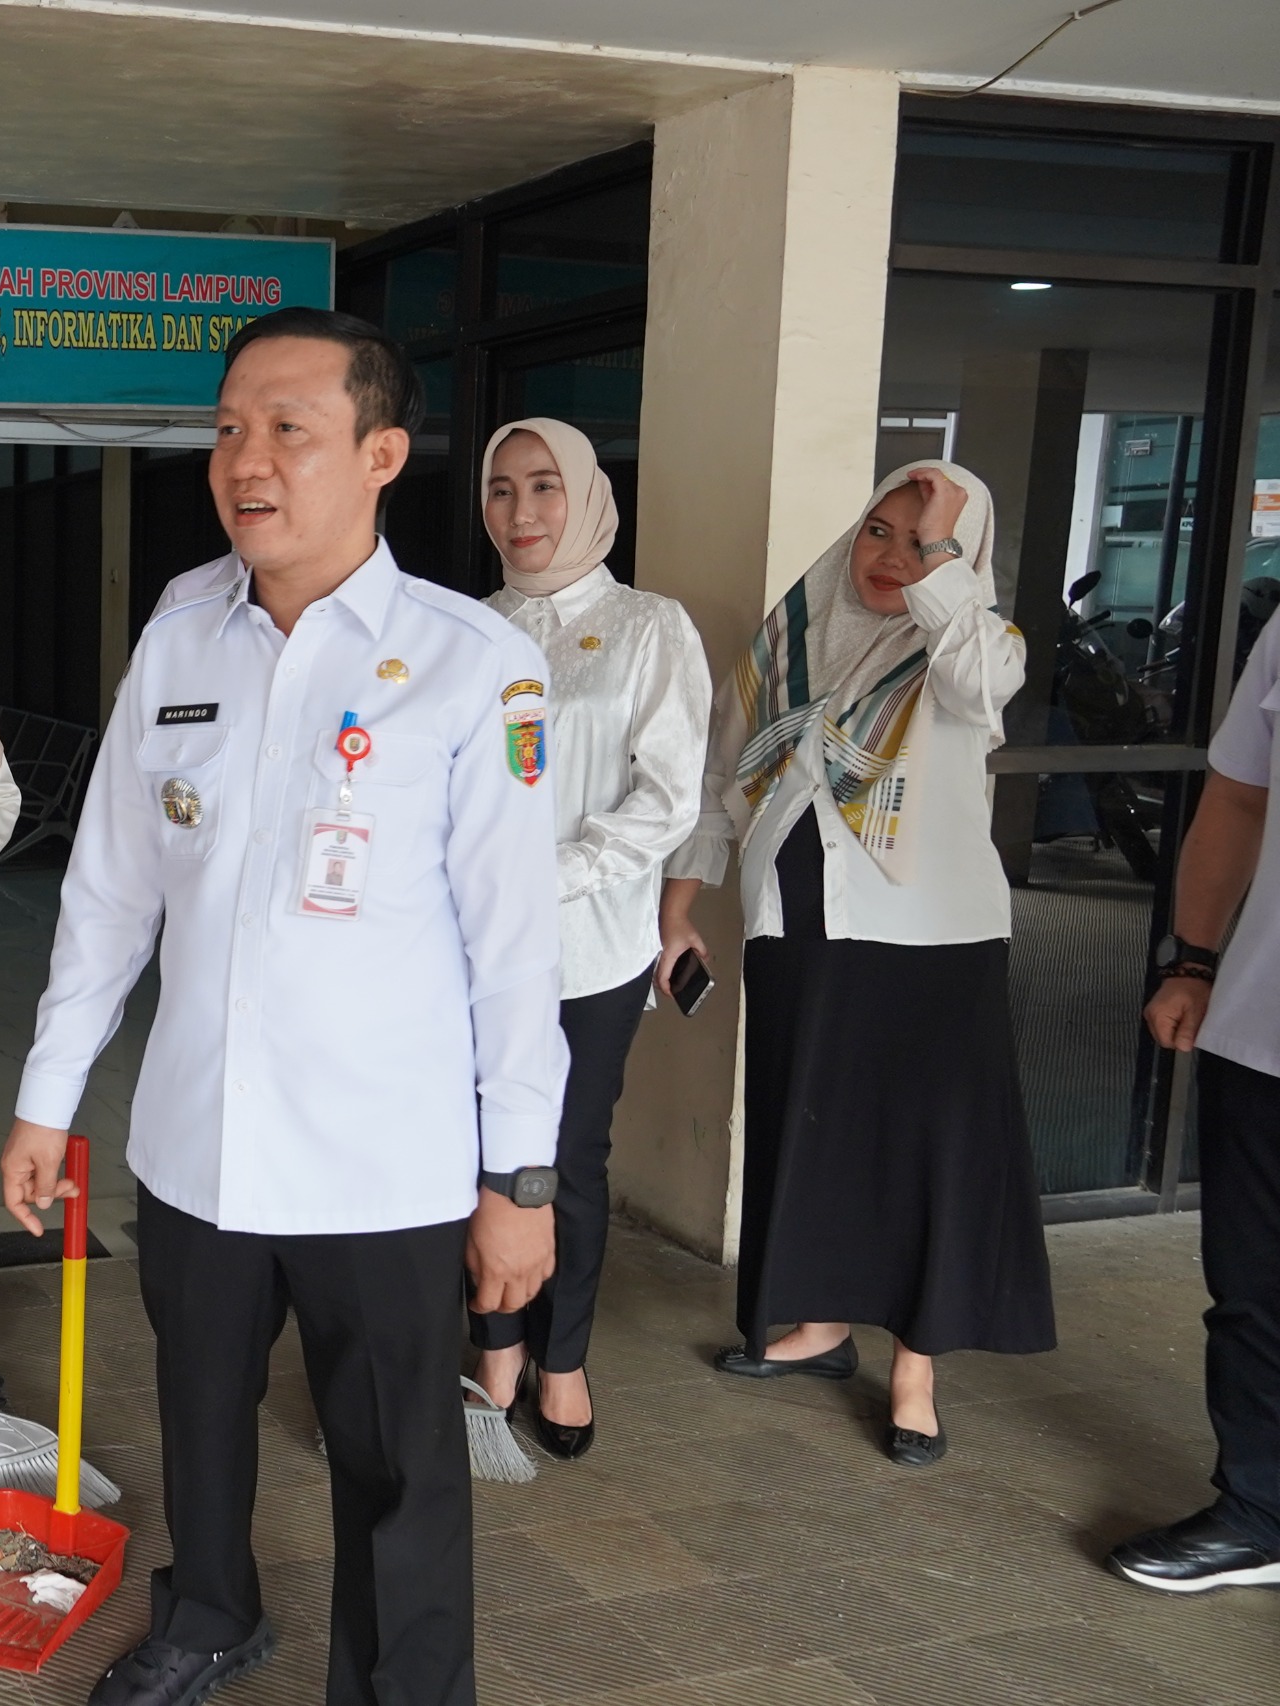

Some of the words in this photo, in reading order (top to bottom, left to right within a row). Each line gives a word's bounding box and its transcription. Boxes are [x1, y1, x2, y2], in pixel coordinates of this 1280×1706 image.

[40, 268, 157, 302] PROVINSI
[163, 273, 281, 306] LAMPUNG
[13, 308, 157, 351] INFORMATIKA
[162, 313, 203, 352] DAN
[208, 314, 258, 352] ST
[164, 708, 208, 719] MARINDO
